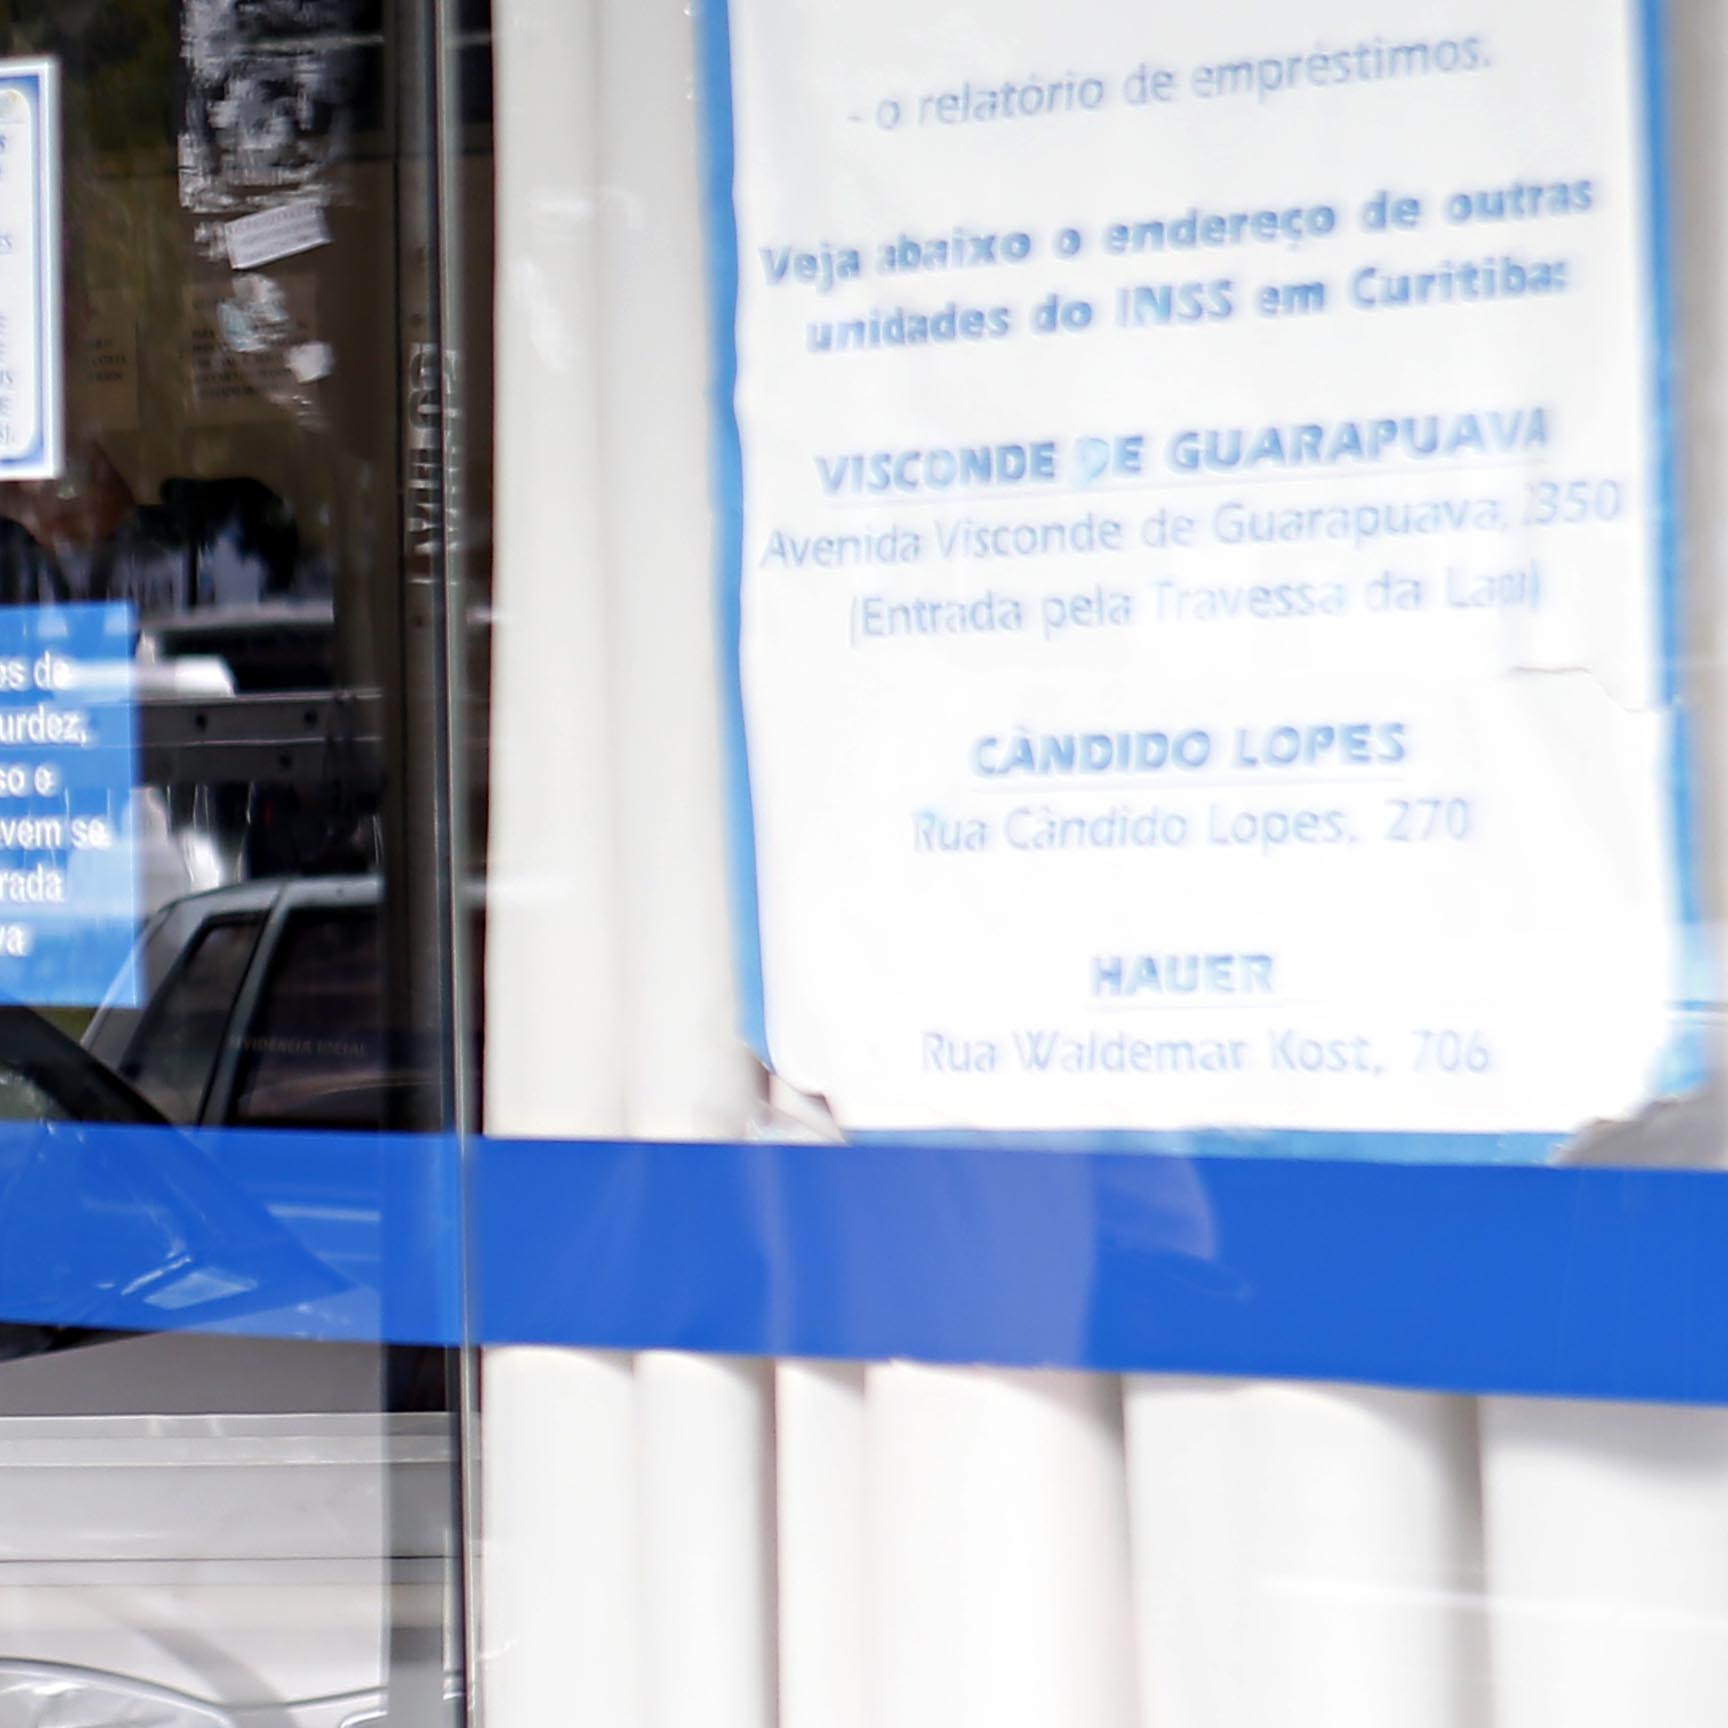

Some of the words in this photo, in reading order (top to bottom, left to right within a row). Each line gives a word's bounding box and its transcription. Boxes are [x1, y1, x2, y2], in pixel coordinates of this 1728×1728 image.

[876, 101, 901, 131] o
[919, 76, 1105, 127] relatório
[1123, 62, 1174, 105] de
[1192, 33, 1493, 104] empréstimos.
[758, 243, 860, 289] Veja
[876, 227, 1032, 276] abaixo
[1053, 227, 1082, 259] o
[1102, 198, 1337, 259] endereço
[1360, 188, 1422, 231] de
[1444, 176, 1594, 220] outras
[806, 295, 1011, 353] unidades
[1032, 291, 1093, 335] do
[1116, 280, 1234, 328] INSS
[1253, 275, 1326, 317] em
[1350, 255, 1568, 312] Curitiba:
[814, 437, 1057, 496] VISCONDE
[1075, 433, 1144, 480] DE
[1168, 406, 1549, 472] GUARAPUAVA
[759, 516, 923, 571] Avenida
[936, 507, 1122, 560] Visconde
[1141, 506, 1195, 549] de
[848, 588, 1023, 647] (Entrada
[1042, 584, 1132, 640] pela
[1149, 576, 1343, 624] Travessa
[1364, 571, 1423, 613] da
[33, 651, 72, 689] de
[1232, 721, 1408, 770] LOPES
[33, 764, 56, 796] e
[913, 810, 987, 853] Rua
[1003, 801, 1188, 851] Cândido
[1383, 797, 1472, 842] 270
[1089, 952, 1276, 997] HAUER
[921, 1031, 997, 1072] Rua
[1012, 1027, 1246, 1075] Waldemar
[1409, 1027, 1492, 1075] 706
